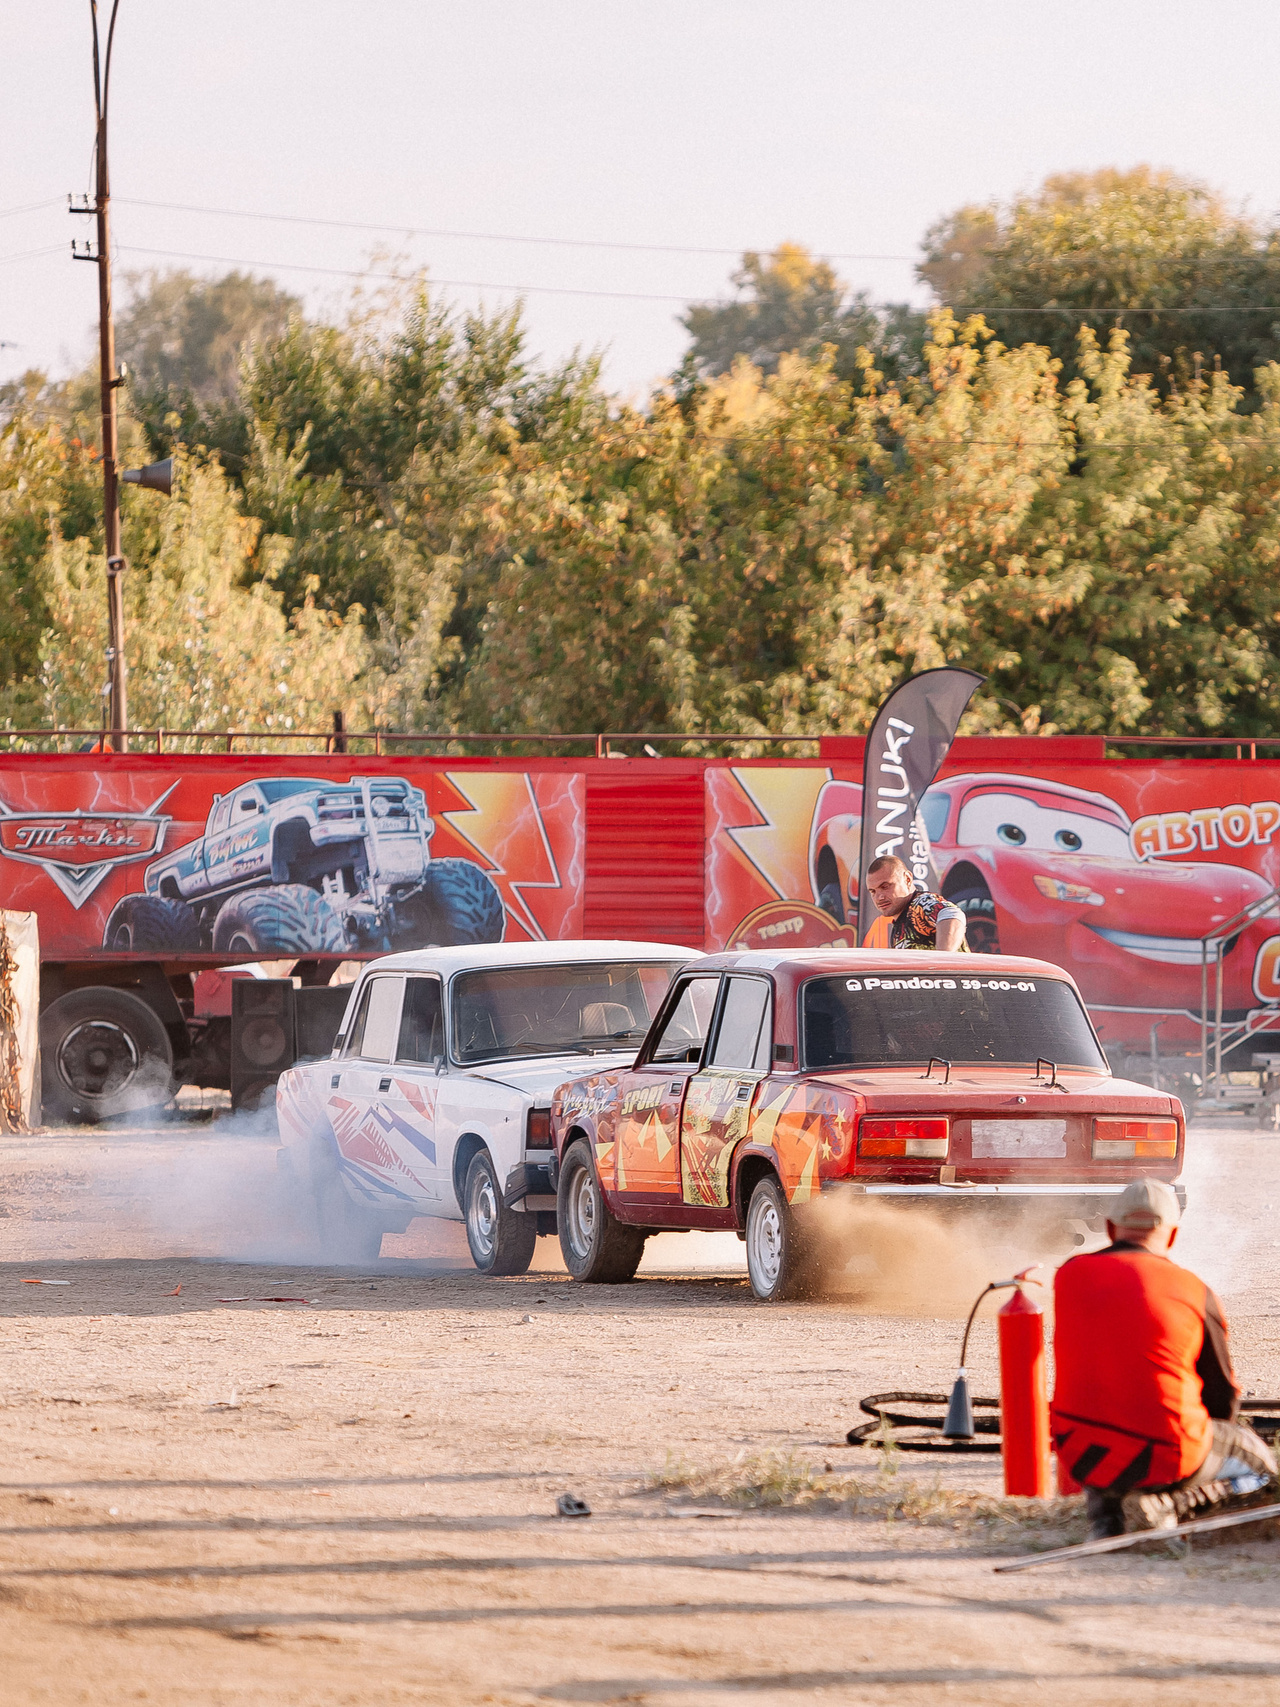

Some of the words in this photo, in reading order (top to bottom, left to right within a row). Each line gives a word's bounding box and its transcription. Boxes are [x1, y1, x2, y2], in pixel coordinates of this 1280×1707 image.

[875, 717, 915, 858] ANUKI
[864, 977, 957, 990] Pandora
[961, 979, 1036, 992] 39-00-01
[621, 1082, 667, 1116] SPORT
